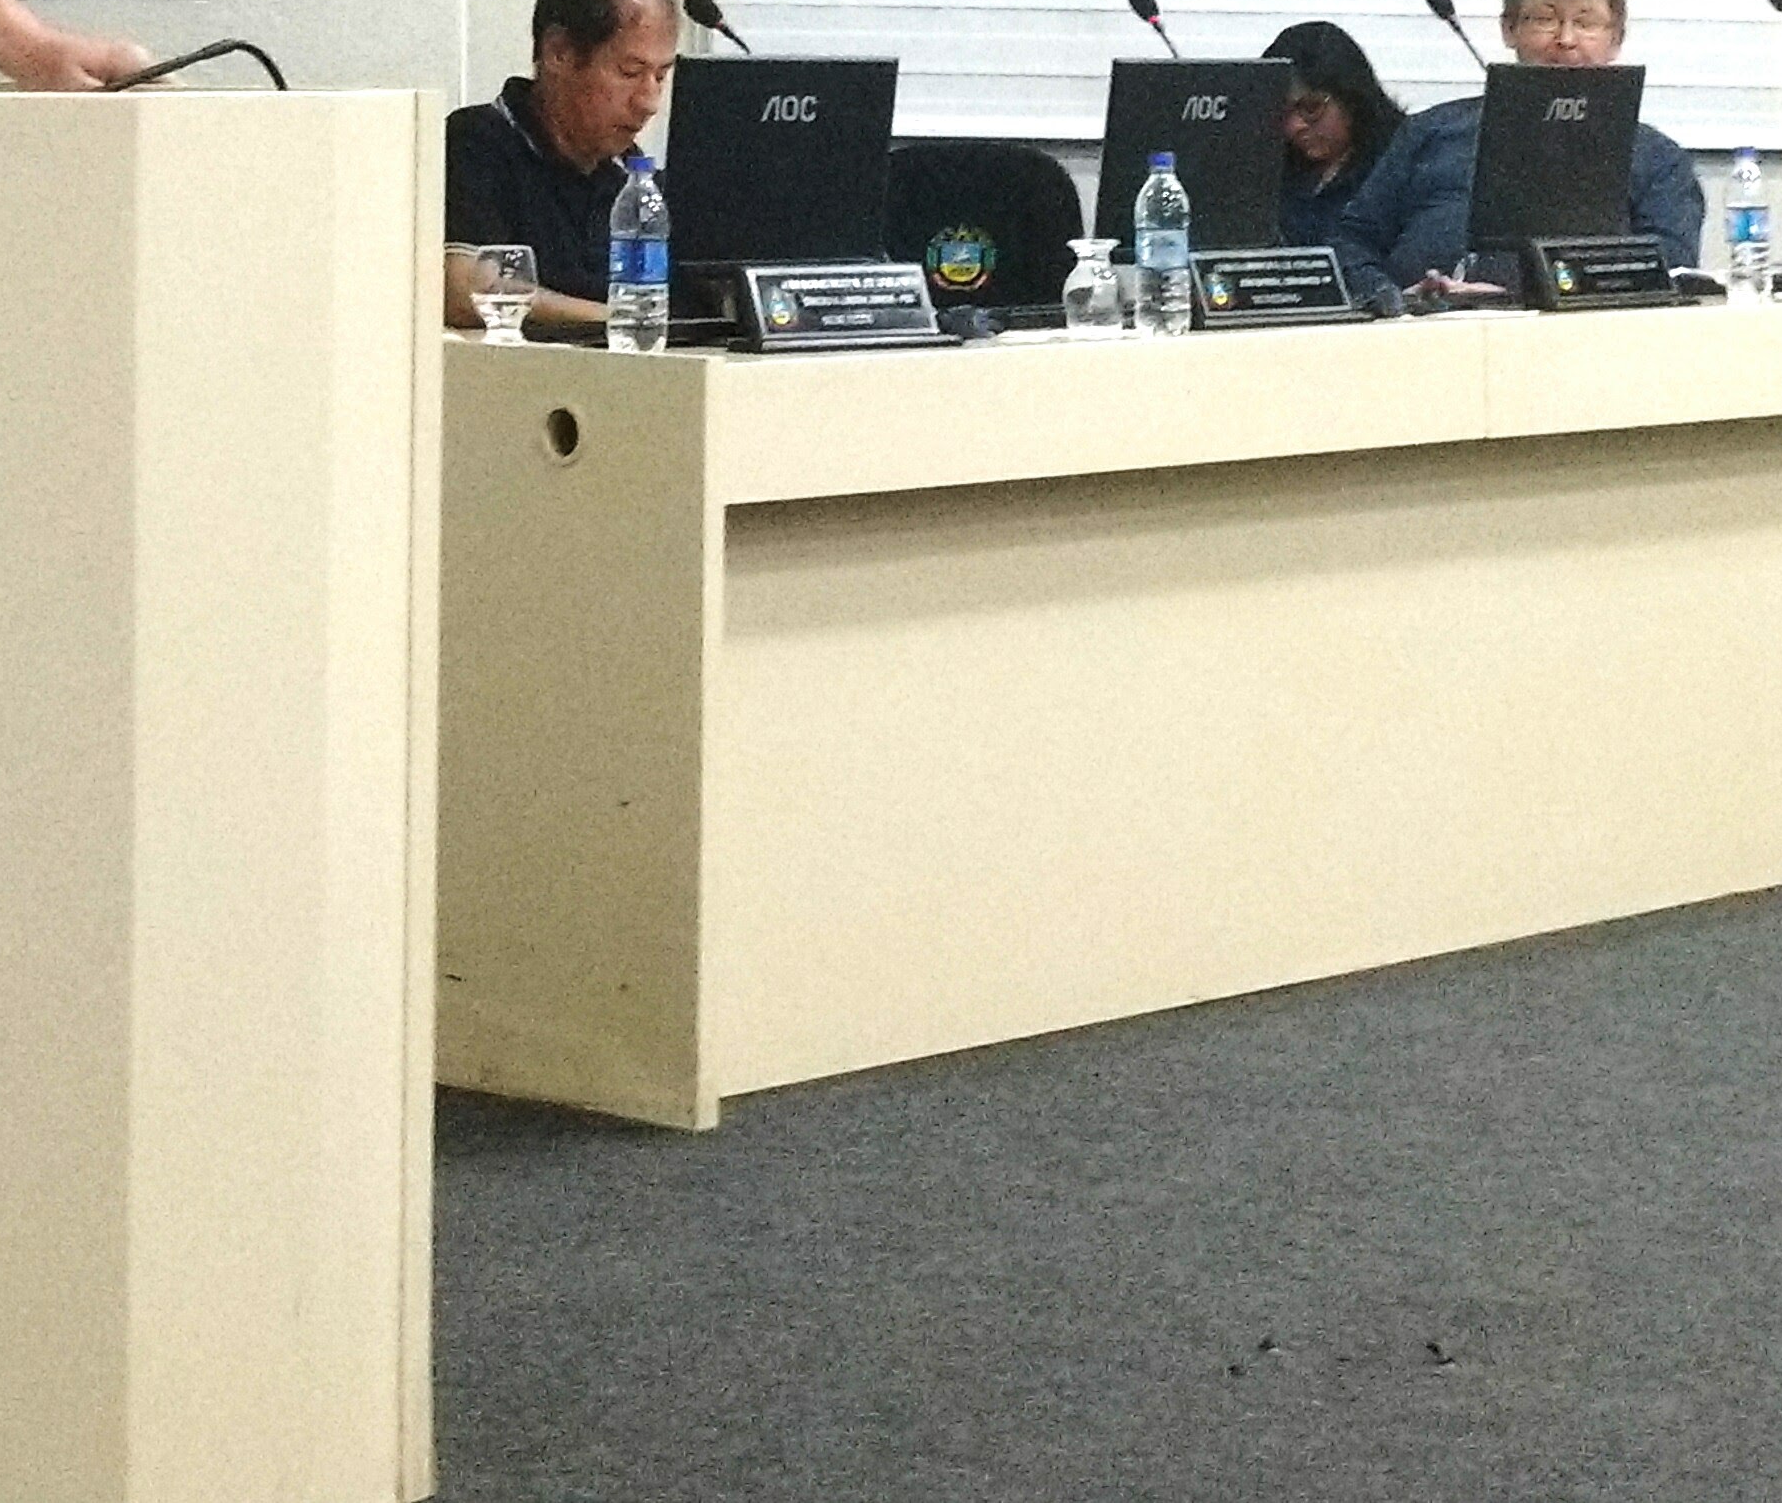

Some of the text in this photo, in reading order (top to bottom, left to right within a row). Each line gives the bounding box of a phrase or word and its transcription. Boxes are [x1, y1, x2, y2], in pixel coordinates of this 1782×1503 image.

[760, 95, 818, 122] AOC
[1181, 94, 1228, 120] AOC
[1542, 97, 1587, 121] AOC
